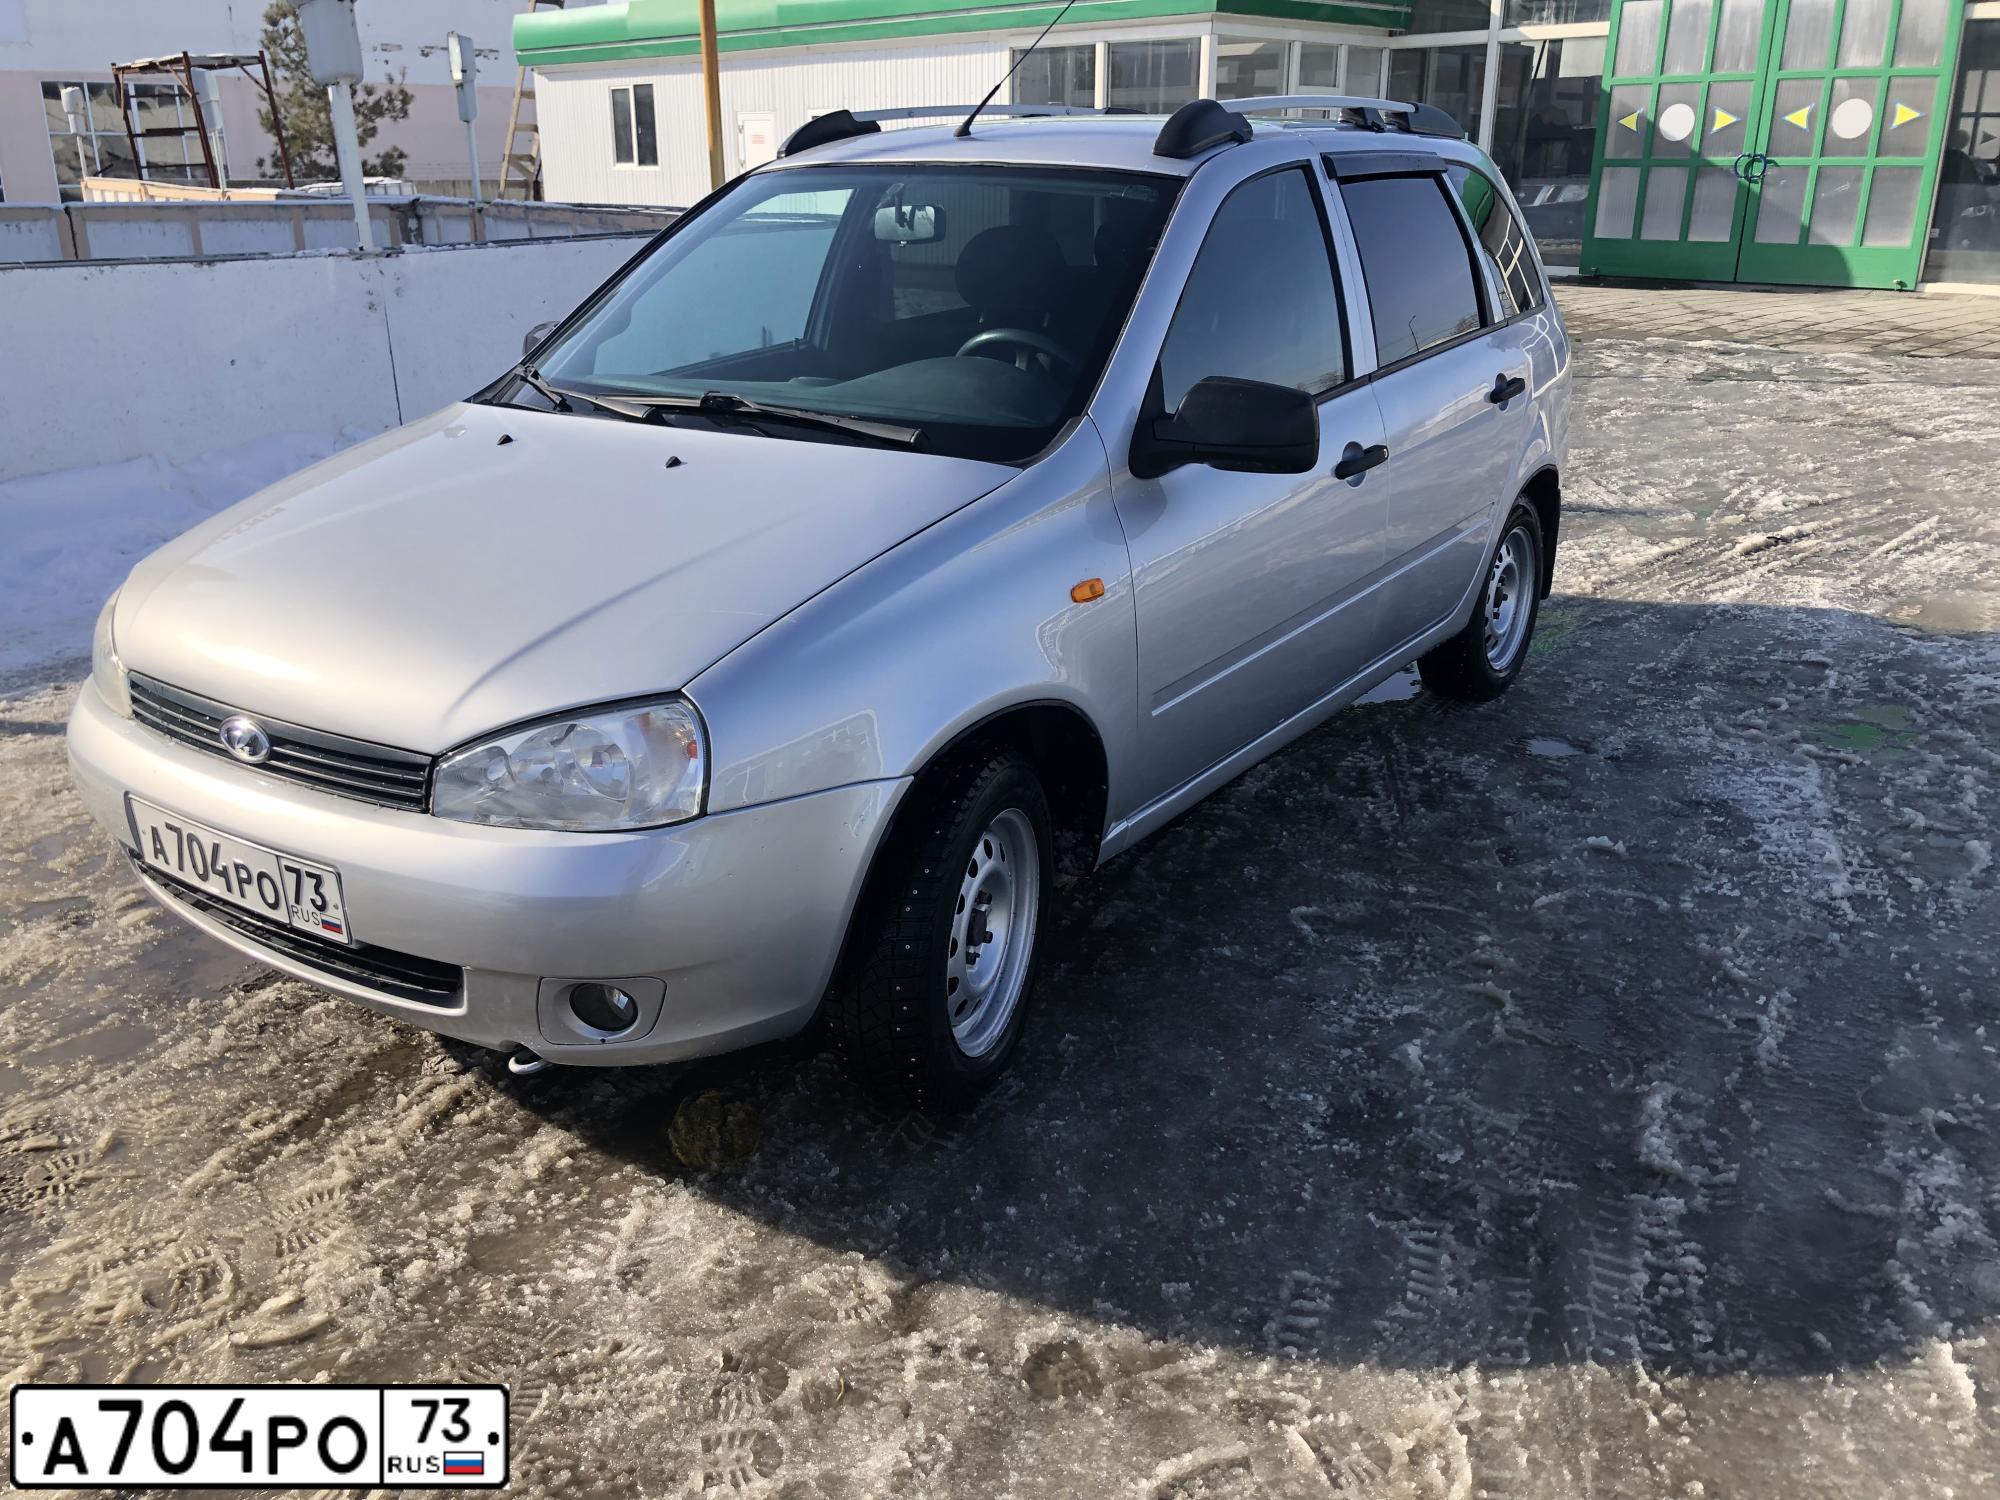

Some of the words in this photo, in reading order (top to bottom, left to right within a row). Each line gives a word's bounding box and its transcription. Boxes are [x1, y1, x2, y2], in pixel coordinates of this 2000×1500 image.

[150, 822, 281, 911] A704PO
[283, 864, 328, 913] 73
[290, 904, 321, 927] RUS
